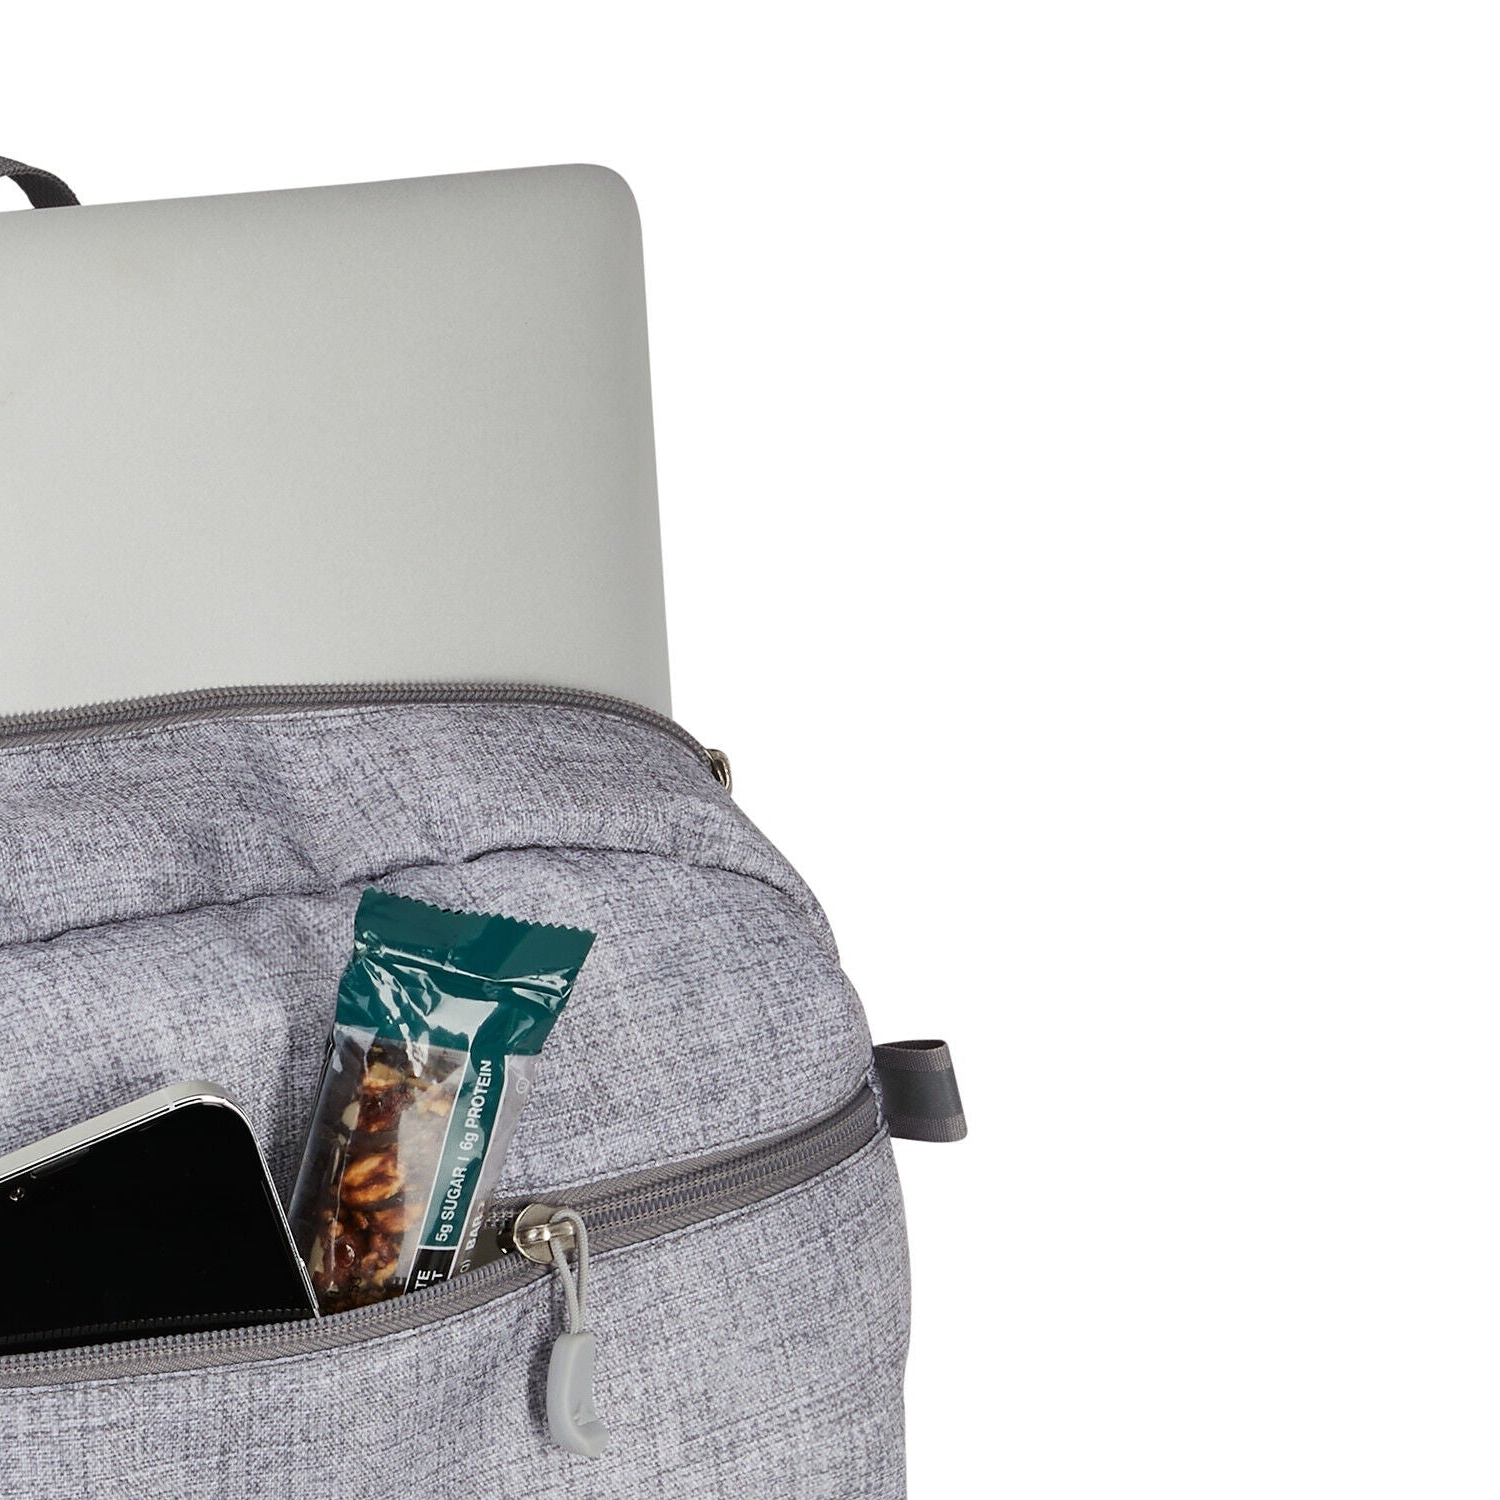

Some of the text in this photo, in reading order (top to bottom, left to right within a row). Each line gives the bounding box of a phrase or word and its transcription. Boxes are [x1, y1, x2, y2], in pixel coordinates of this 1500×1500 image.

[465, 1060, 492, 1128] PROTEIN
[460, 1132, 479, 1151] 6g
[441, 1167, 468, 1221] SUGAR
[435, 1225, 453, 1242] 5g
